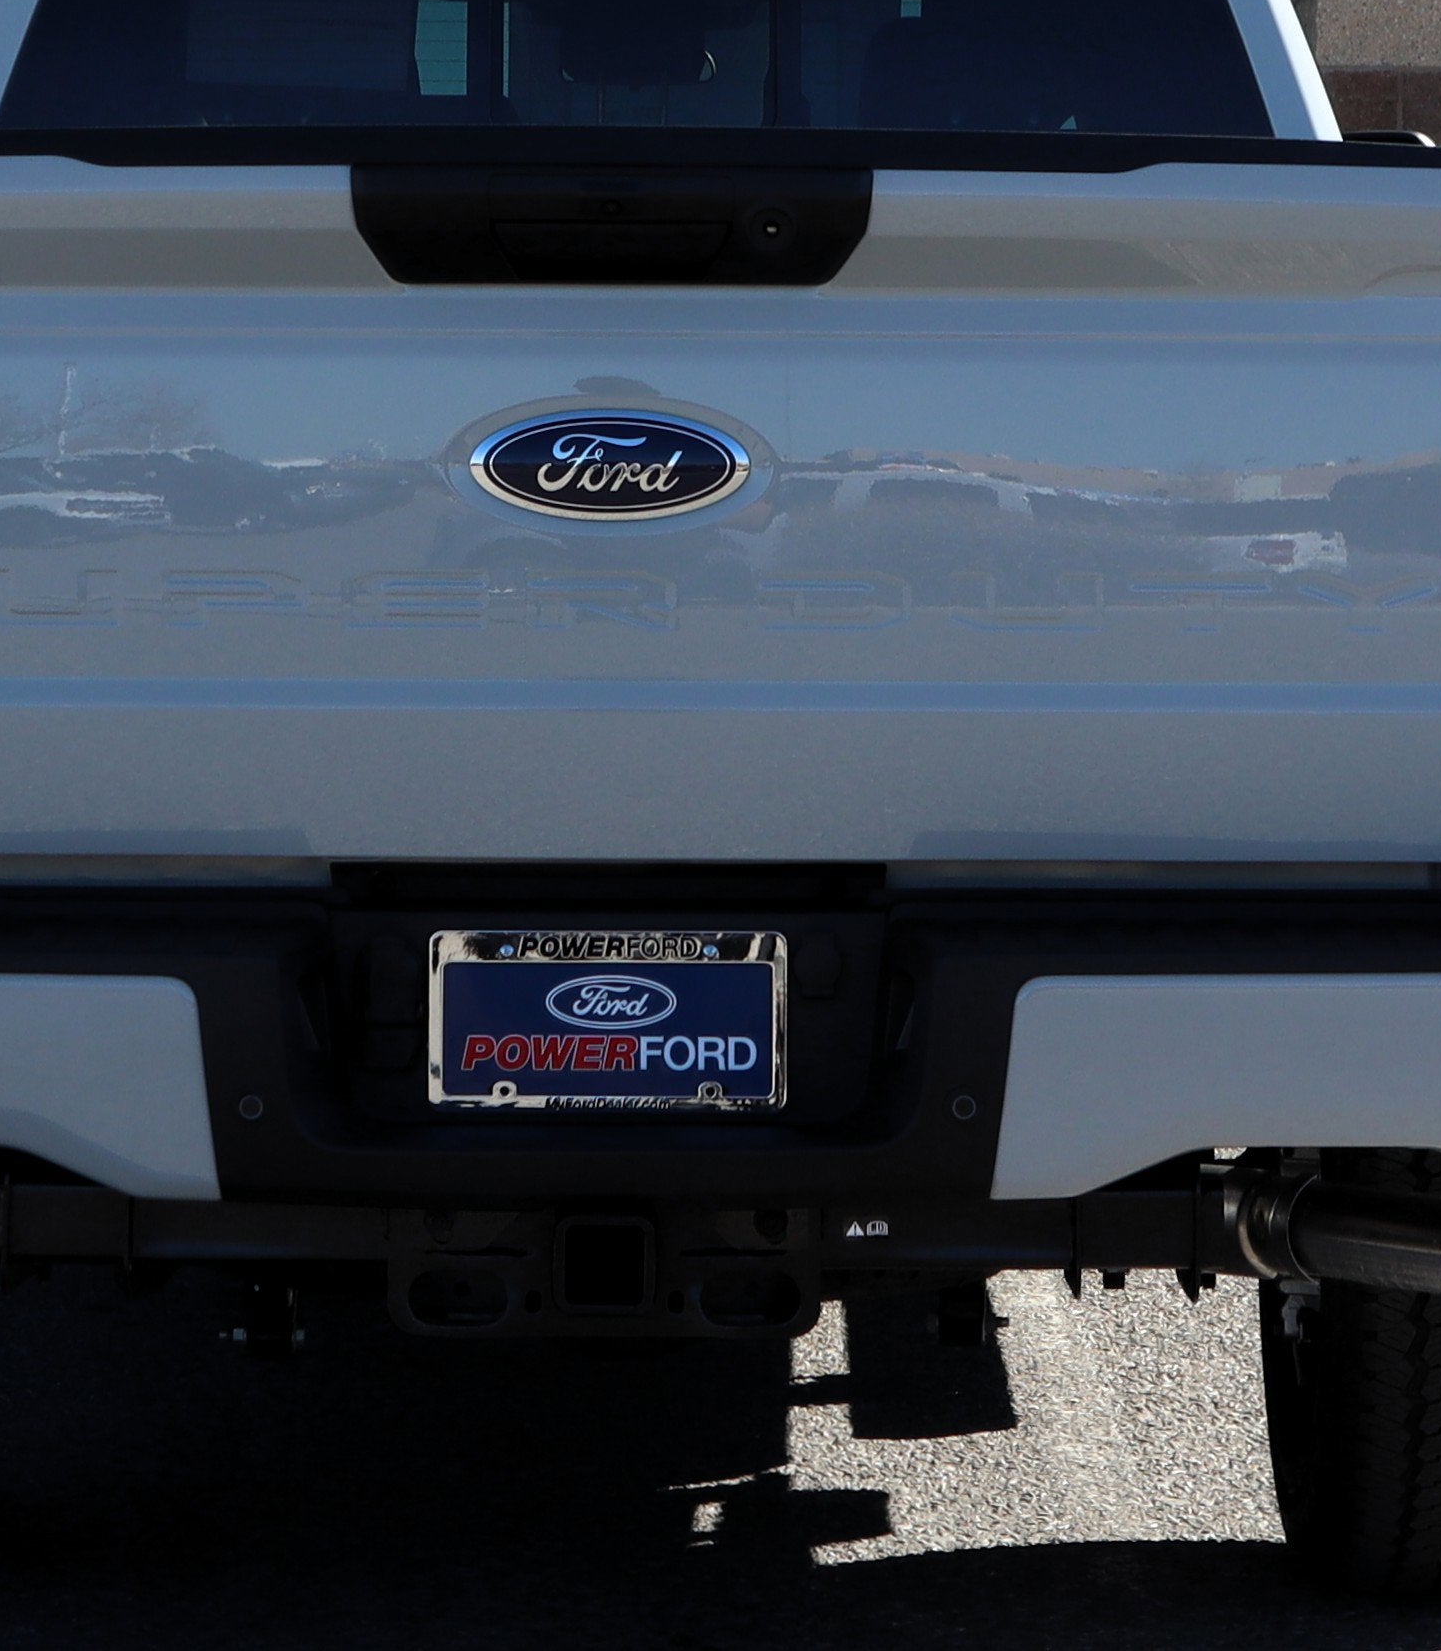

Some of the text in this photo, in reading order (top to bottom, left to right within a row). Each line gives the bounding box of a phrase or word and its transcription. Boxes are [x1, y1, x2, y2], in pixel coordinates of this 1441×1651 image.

[537, 433, 683, 492] Ford
[757, 570, 1439, 633] DUTY
[572, 986, 649, 1017] Ford
